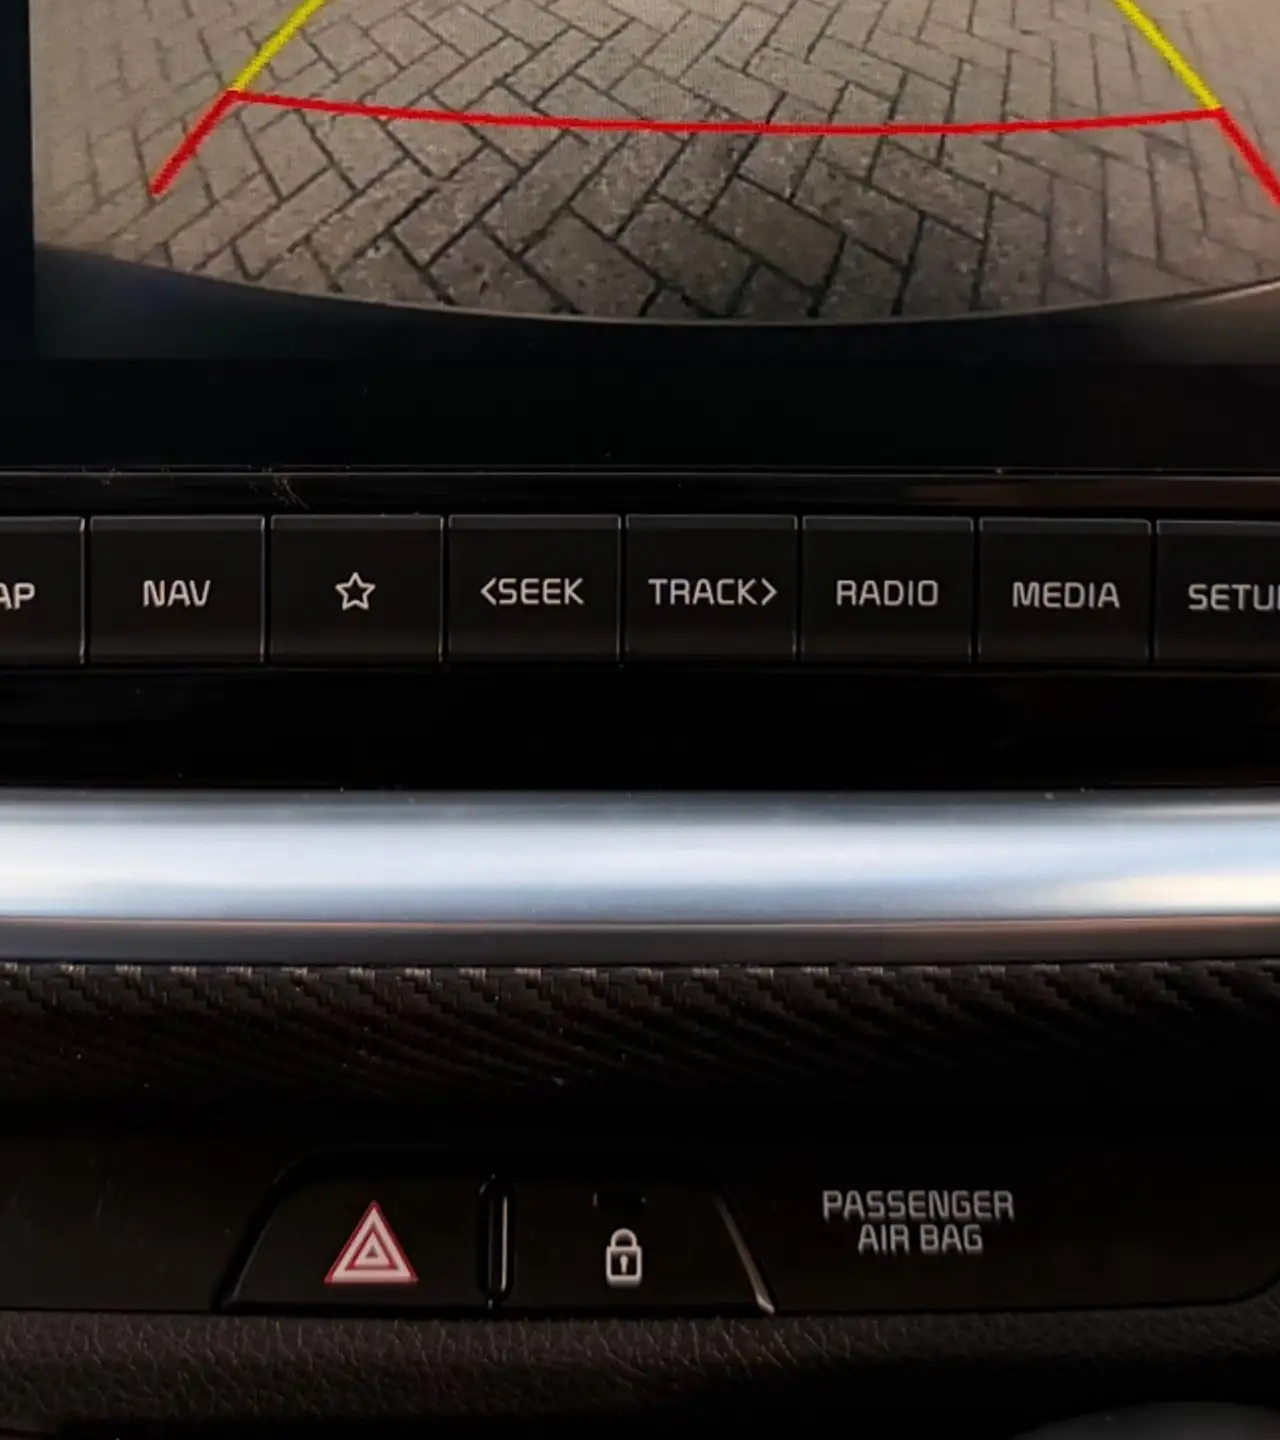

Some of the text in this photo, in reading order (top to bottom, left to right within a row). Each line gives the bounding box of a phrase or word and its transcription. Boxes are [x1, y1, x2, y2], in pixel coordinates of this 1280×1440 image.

[143, 579, 211, 608] NAV
[836, 579, 938, 606] RADIO
[1012, 581, 1120, 609] MEDIA
[822, 1190, 1015, 1221] PASSENGER
[857, 1223, 983, 1254] AIR BAG
